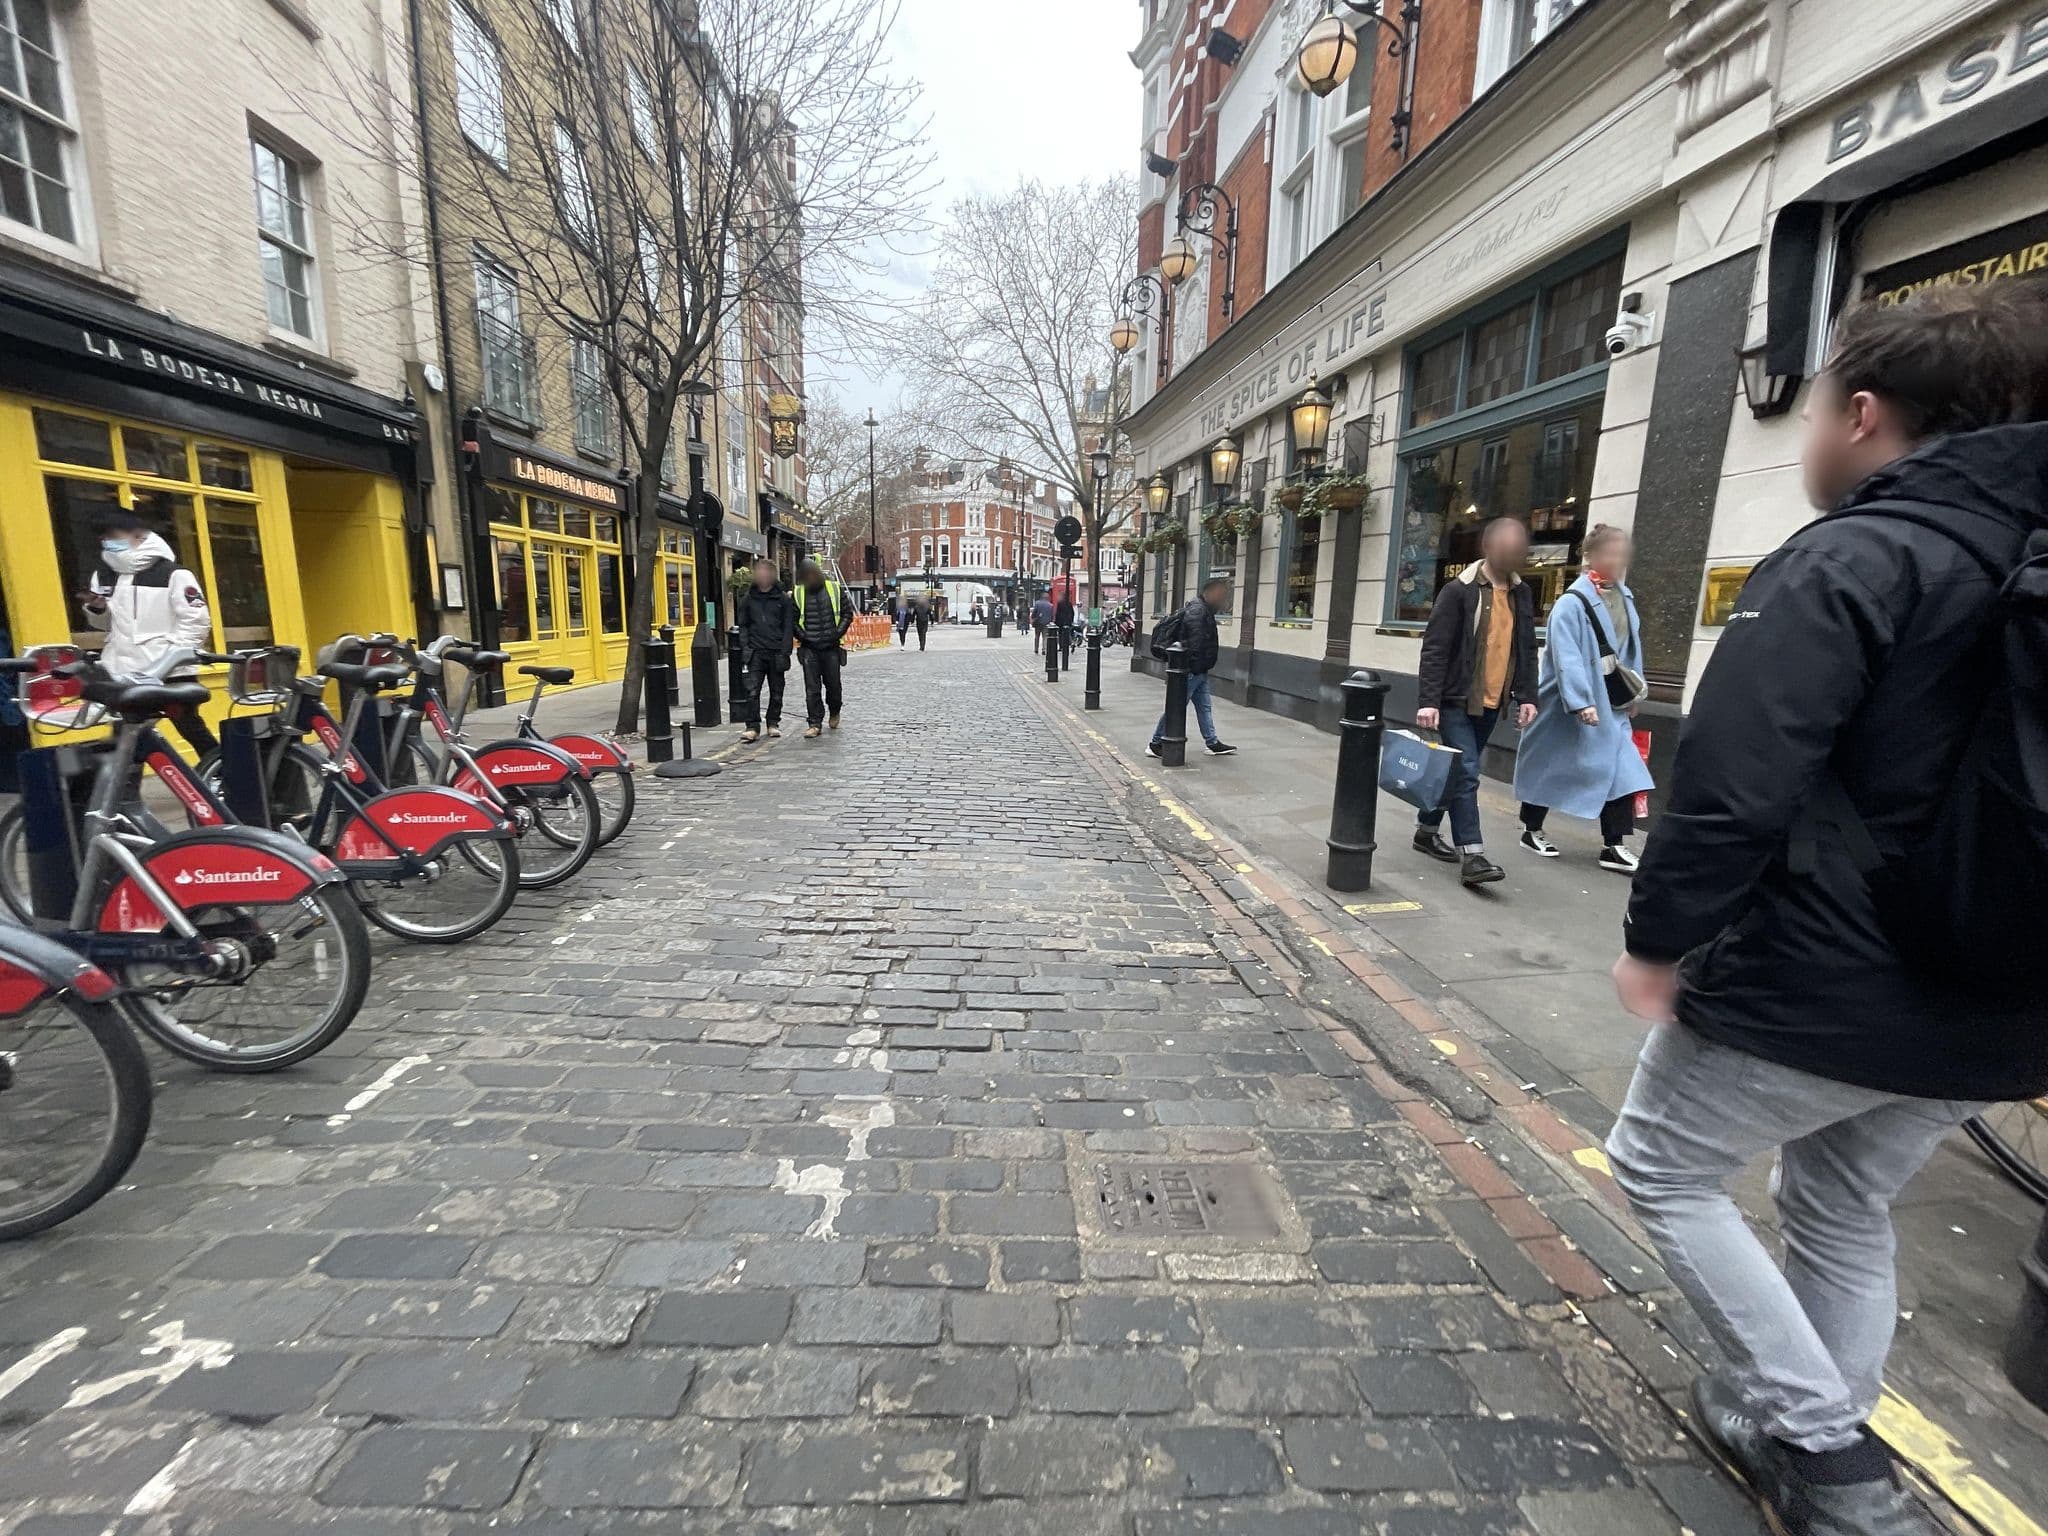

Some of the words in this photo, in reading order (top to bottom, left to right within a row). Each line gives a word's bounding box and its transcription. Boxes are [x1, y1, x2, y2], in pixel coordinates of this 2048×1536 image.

[83, 331, 123, 361] LA
[140, 348, 245, 395] BODEGA
[255, 383, 322, 419] NEGRA
[1201, 402, 1225, 437] THE
[1230, 365, 1280, 420] SPICE
[1287, 339, 1317, 384] OF
[1326, 291, 1387, 362] LIFE
[516, 457, 535, 480] LA
[537, 464, 583, 495] BODEGA
[585, 480, 617, 504] NEGRA
[502, 761, 552, 773] Santander
[403, 811, 469, 824] Santander
[194, 866, 281, 884] Santander
